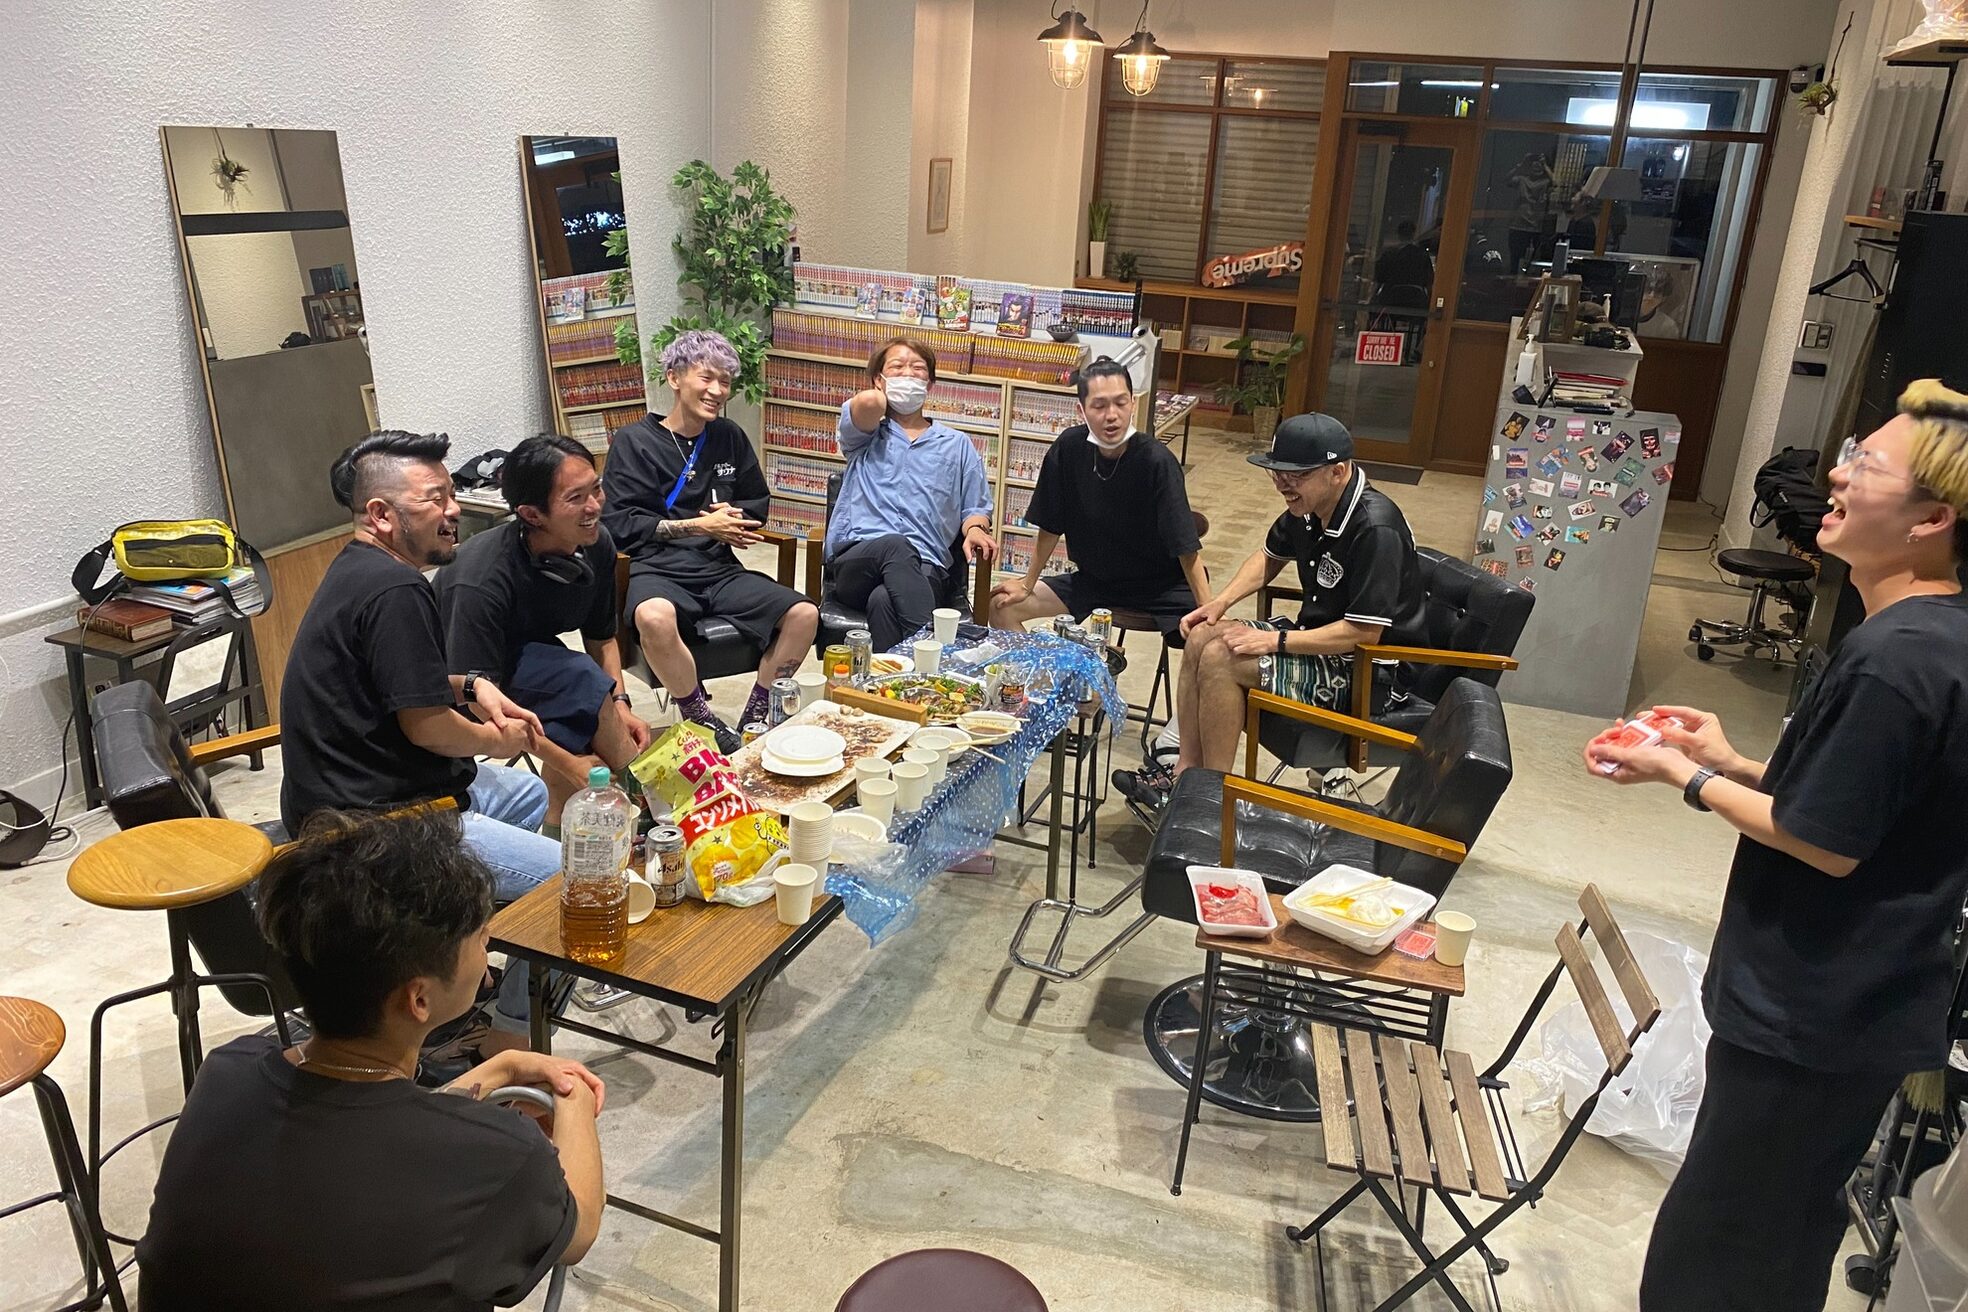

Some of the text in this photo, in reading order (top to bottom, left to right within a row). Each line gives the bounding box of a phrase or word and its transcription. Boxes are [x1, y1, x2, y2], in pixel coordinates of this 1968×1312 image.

[1212, 248, 1303, 279] Supreme
[1363, 344, 1395, 361] CLOSED
[690, 795, 762, 834] コンソメ
